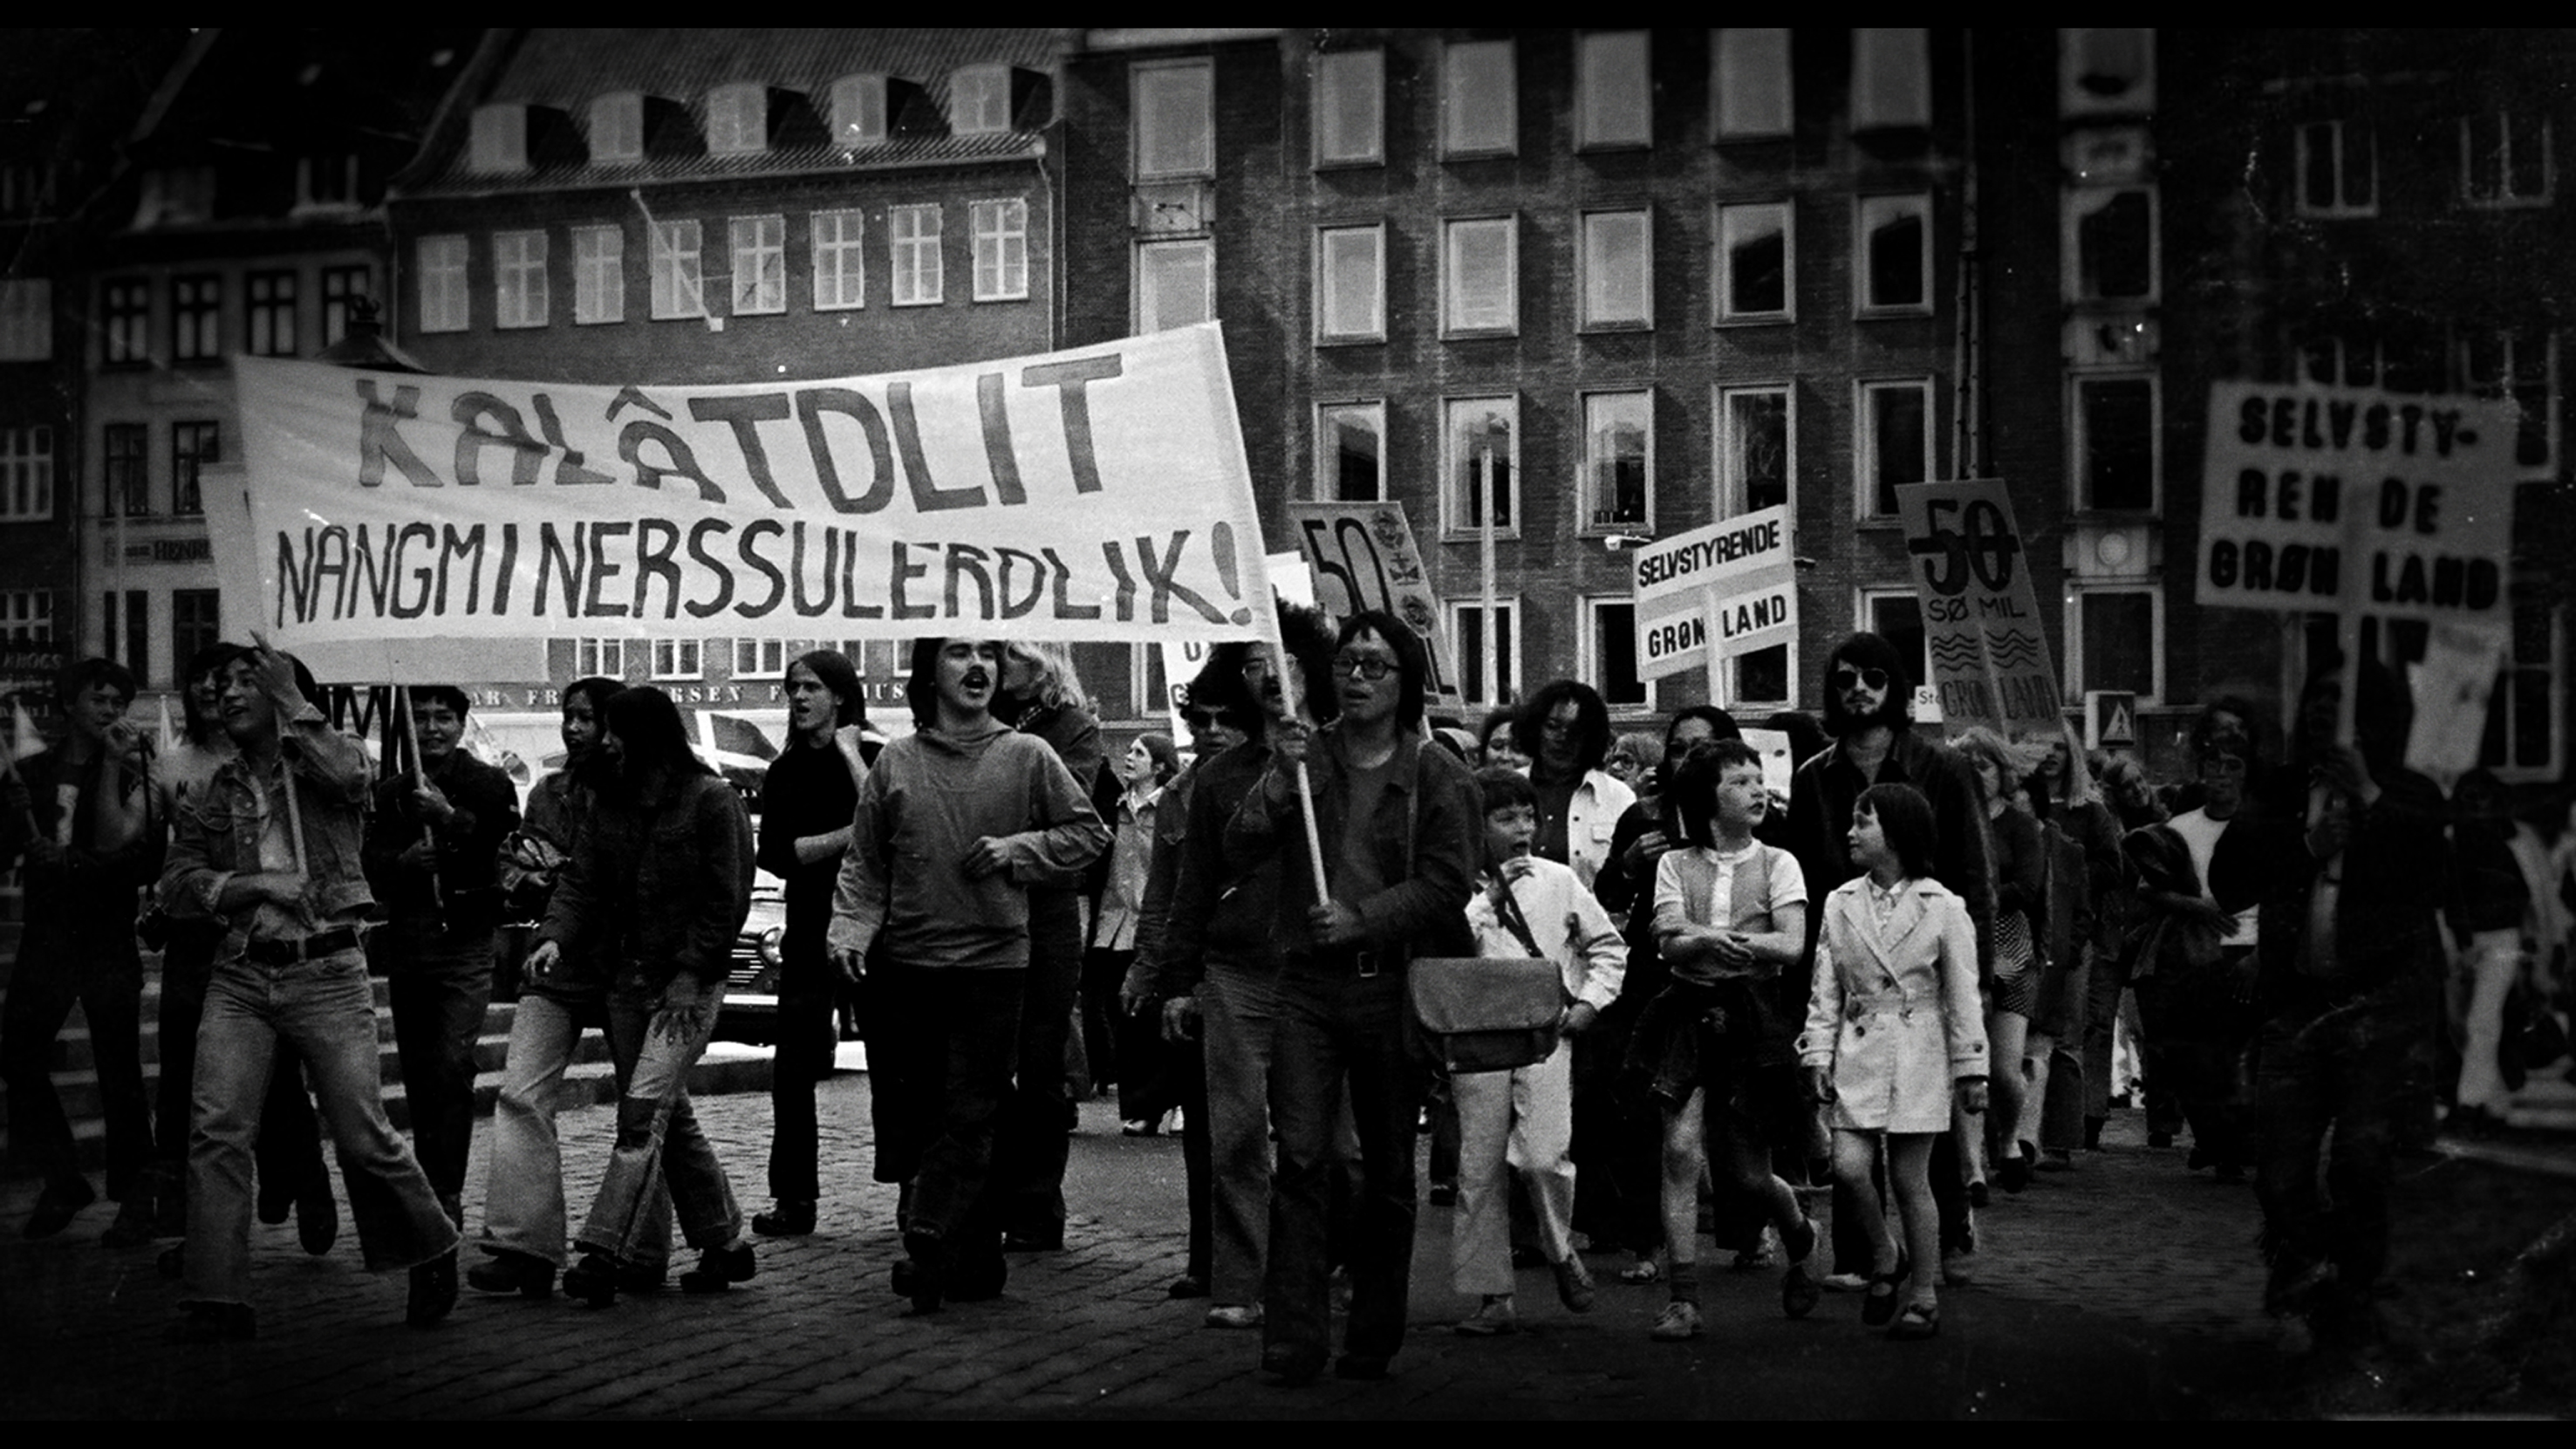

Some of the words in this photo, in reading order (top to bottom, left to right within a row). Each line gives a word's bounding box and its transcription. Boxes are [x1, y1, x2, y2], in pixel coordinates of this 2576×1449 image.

[2379, 477, 2442, 534] DE
[1638, 519, 1780, 589] SELVSTYRENDE
[1915, 499, 2017, 596] 50
[1722, 594, 1787, 639] LAND
[1979, 595, 2026, 619] MIL
